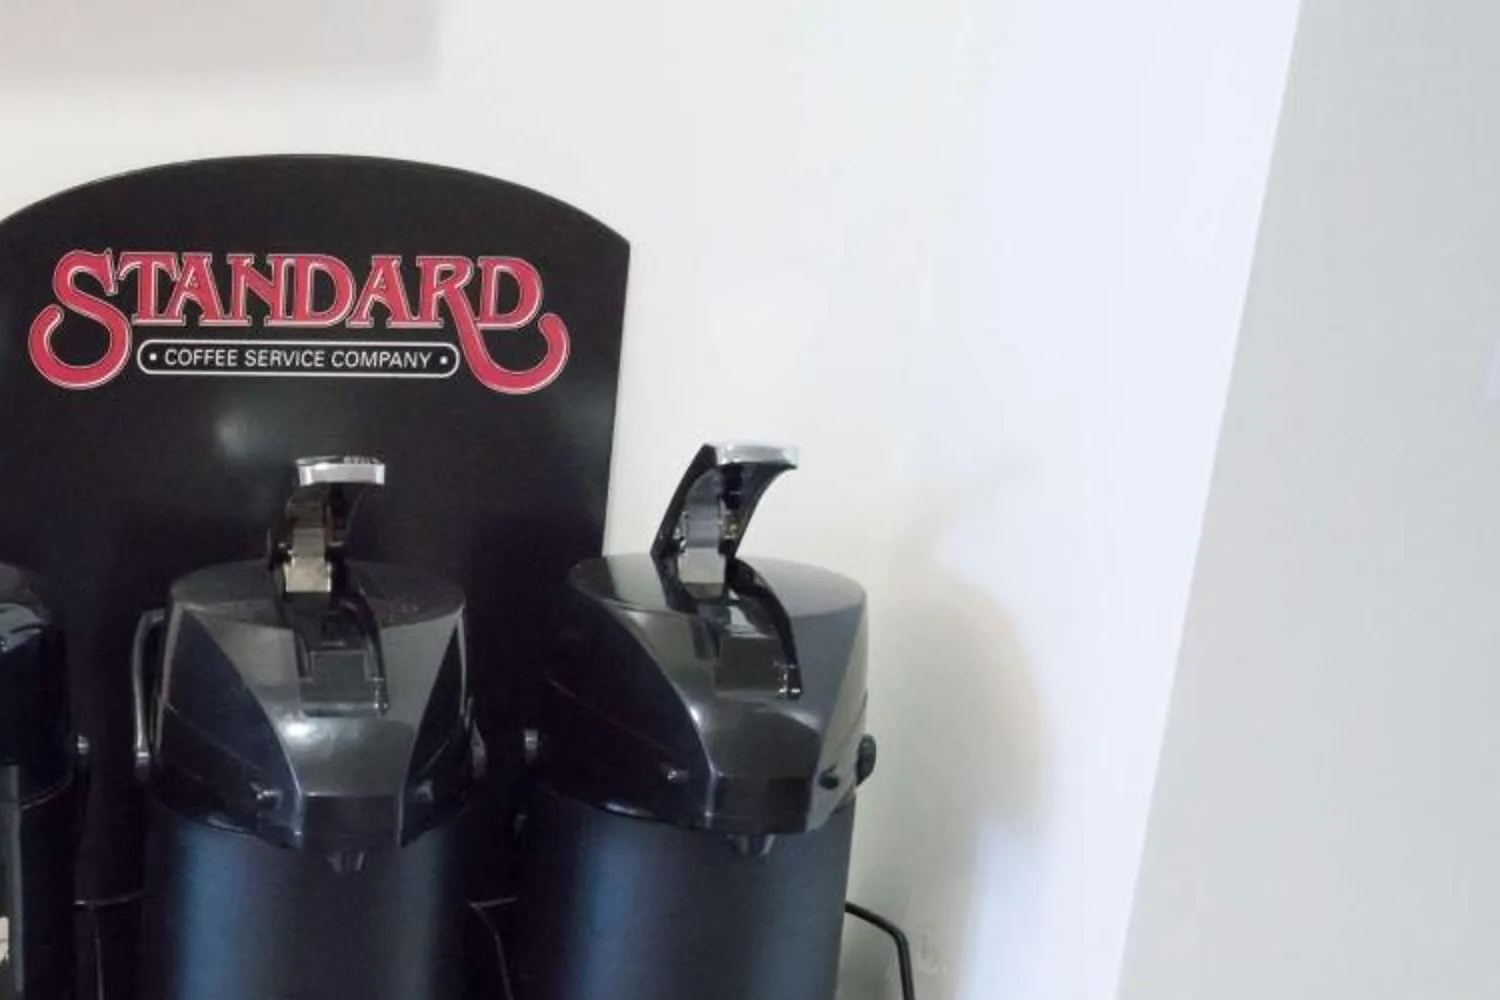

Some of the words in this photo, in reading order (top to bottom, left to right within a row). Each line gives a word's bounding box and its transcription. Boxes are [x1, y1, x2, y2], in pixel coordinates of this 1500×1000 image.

[29, 249, 571, 395] STANDARD
[164, 348, 238, 367] COFFEE
[243, 349, 326, 368] SERVICE
[331, 351, 432, 369] COMPANY
